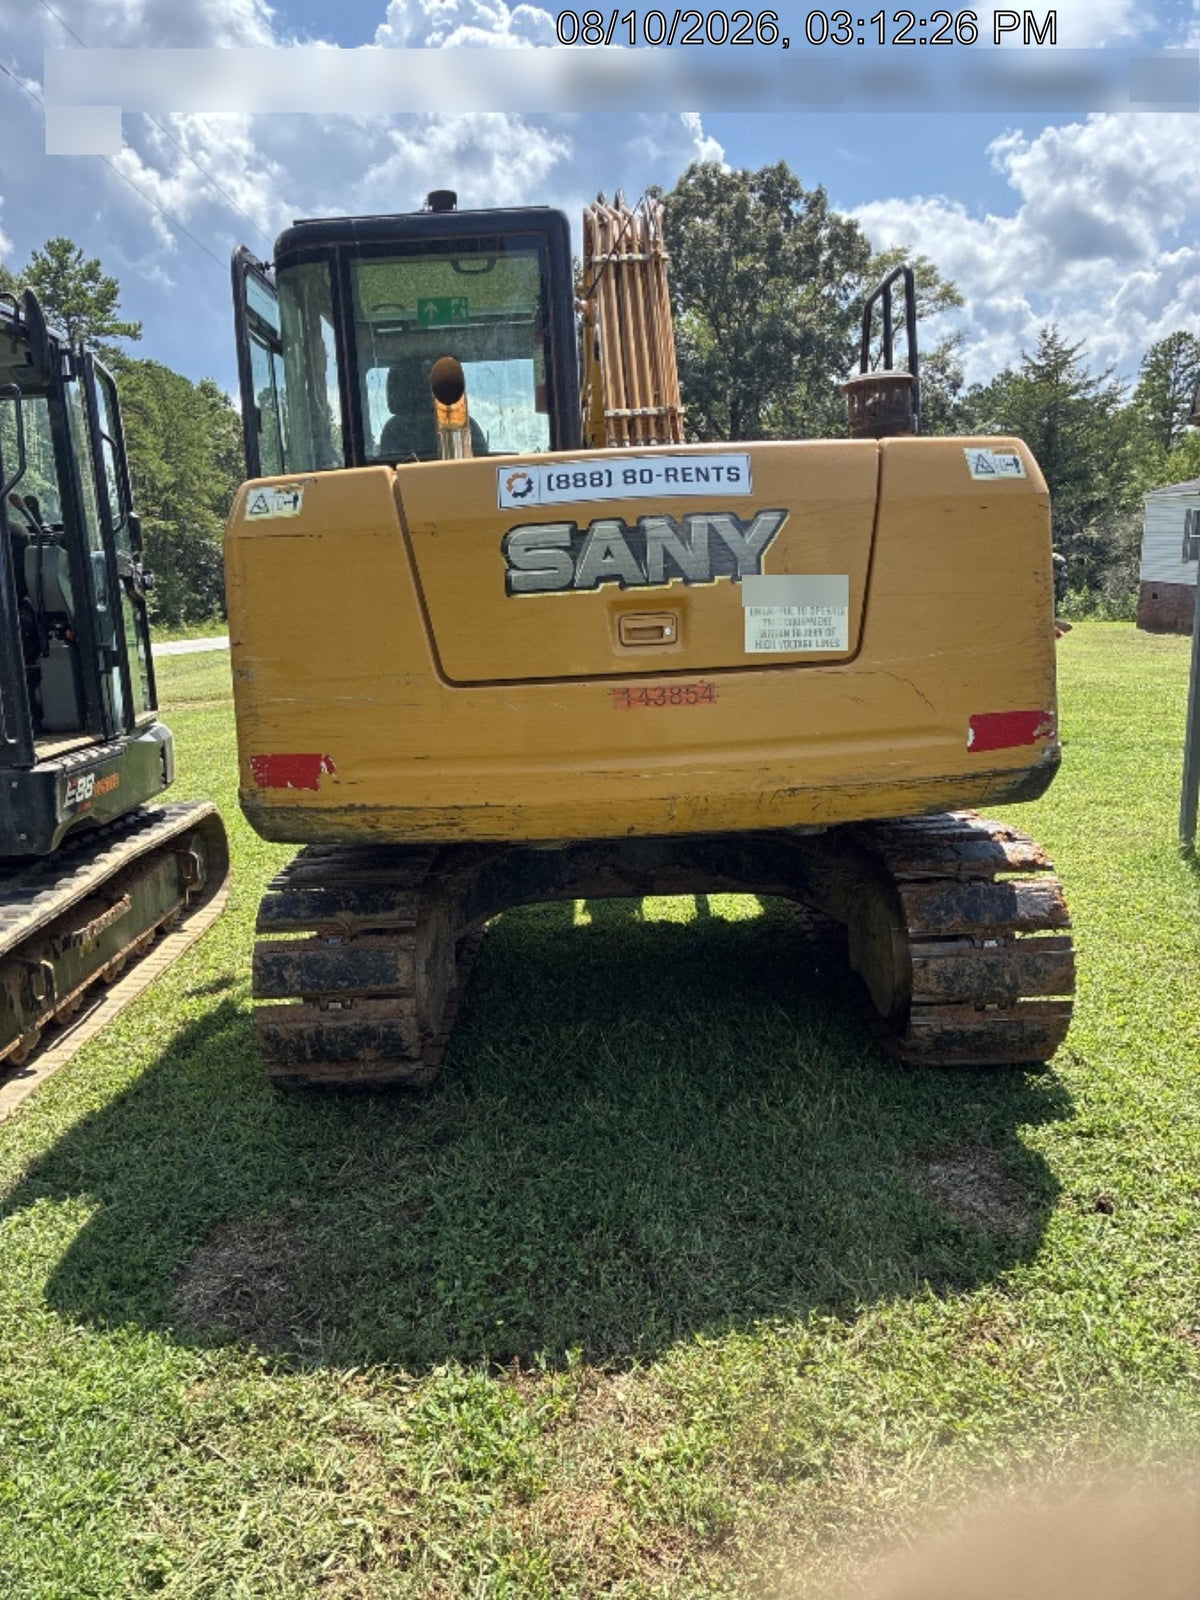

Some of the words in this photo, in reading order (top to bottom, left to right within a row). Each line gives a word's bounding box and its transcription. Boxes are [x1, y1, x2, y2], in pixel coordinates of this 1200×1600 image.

[547, 469, 613, 492] (888)
[622, 466, 741, 485] 80-RENTS
[501, 509, 788, 596] SANY
[749, 606, 794, 616] UNLAUL
